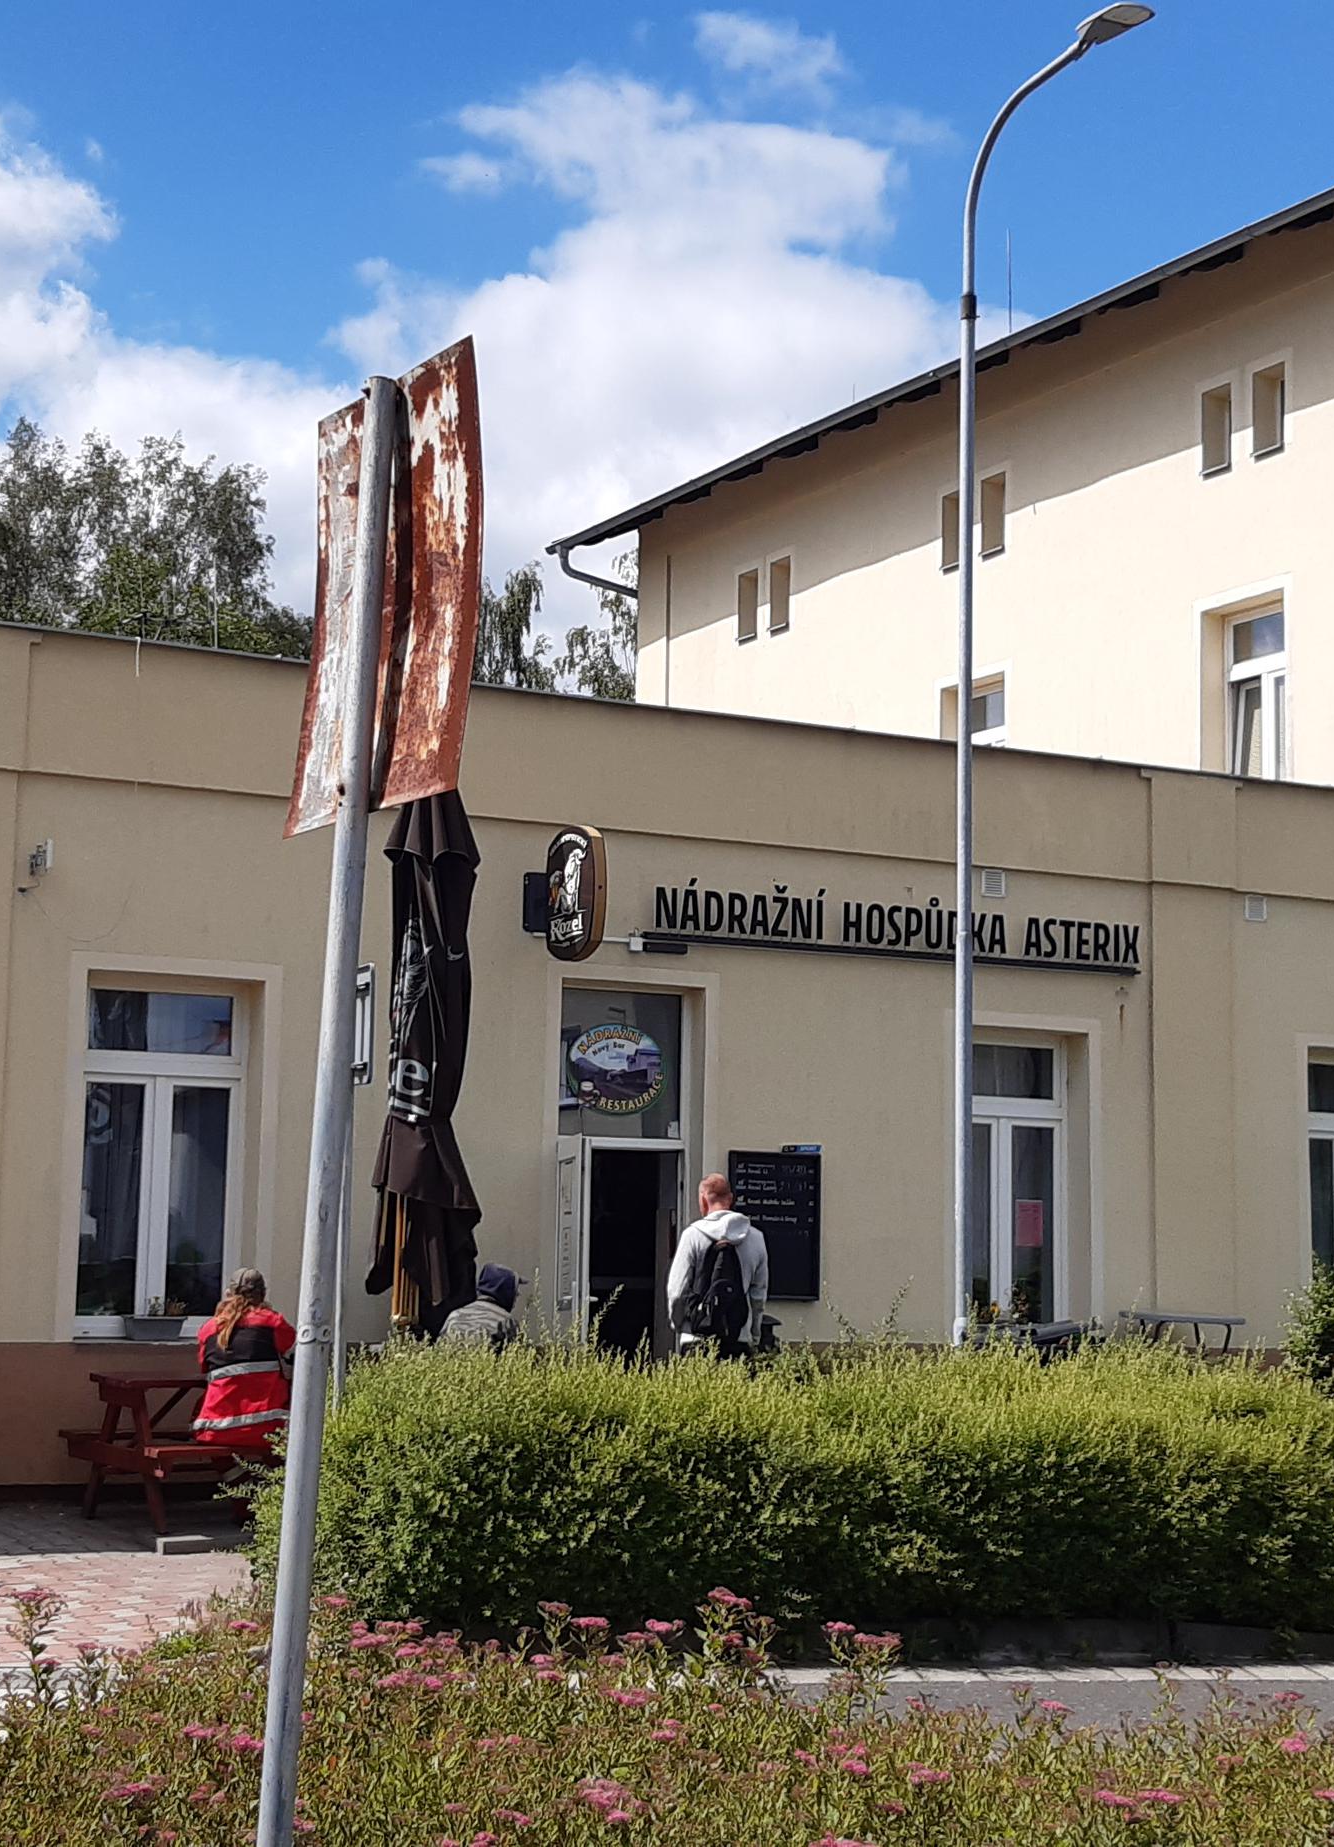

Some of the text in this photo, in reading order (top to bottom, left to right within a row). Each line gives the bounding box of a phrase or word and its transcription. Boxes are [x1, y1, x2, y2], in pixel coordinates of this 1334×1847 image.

[655, 877, 827, 940] NÁDRAŽNÍ
[1024, 917, 1140, 964] ASTERIX
[599, 1071, 664, 1111] RESTAURACE
